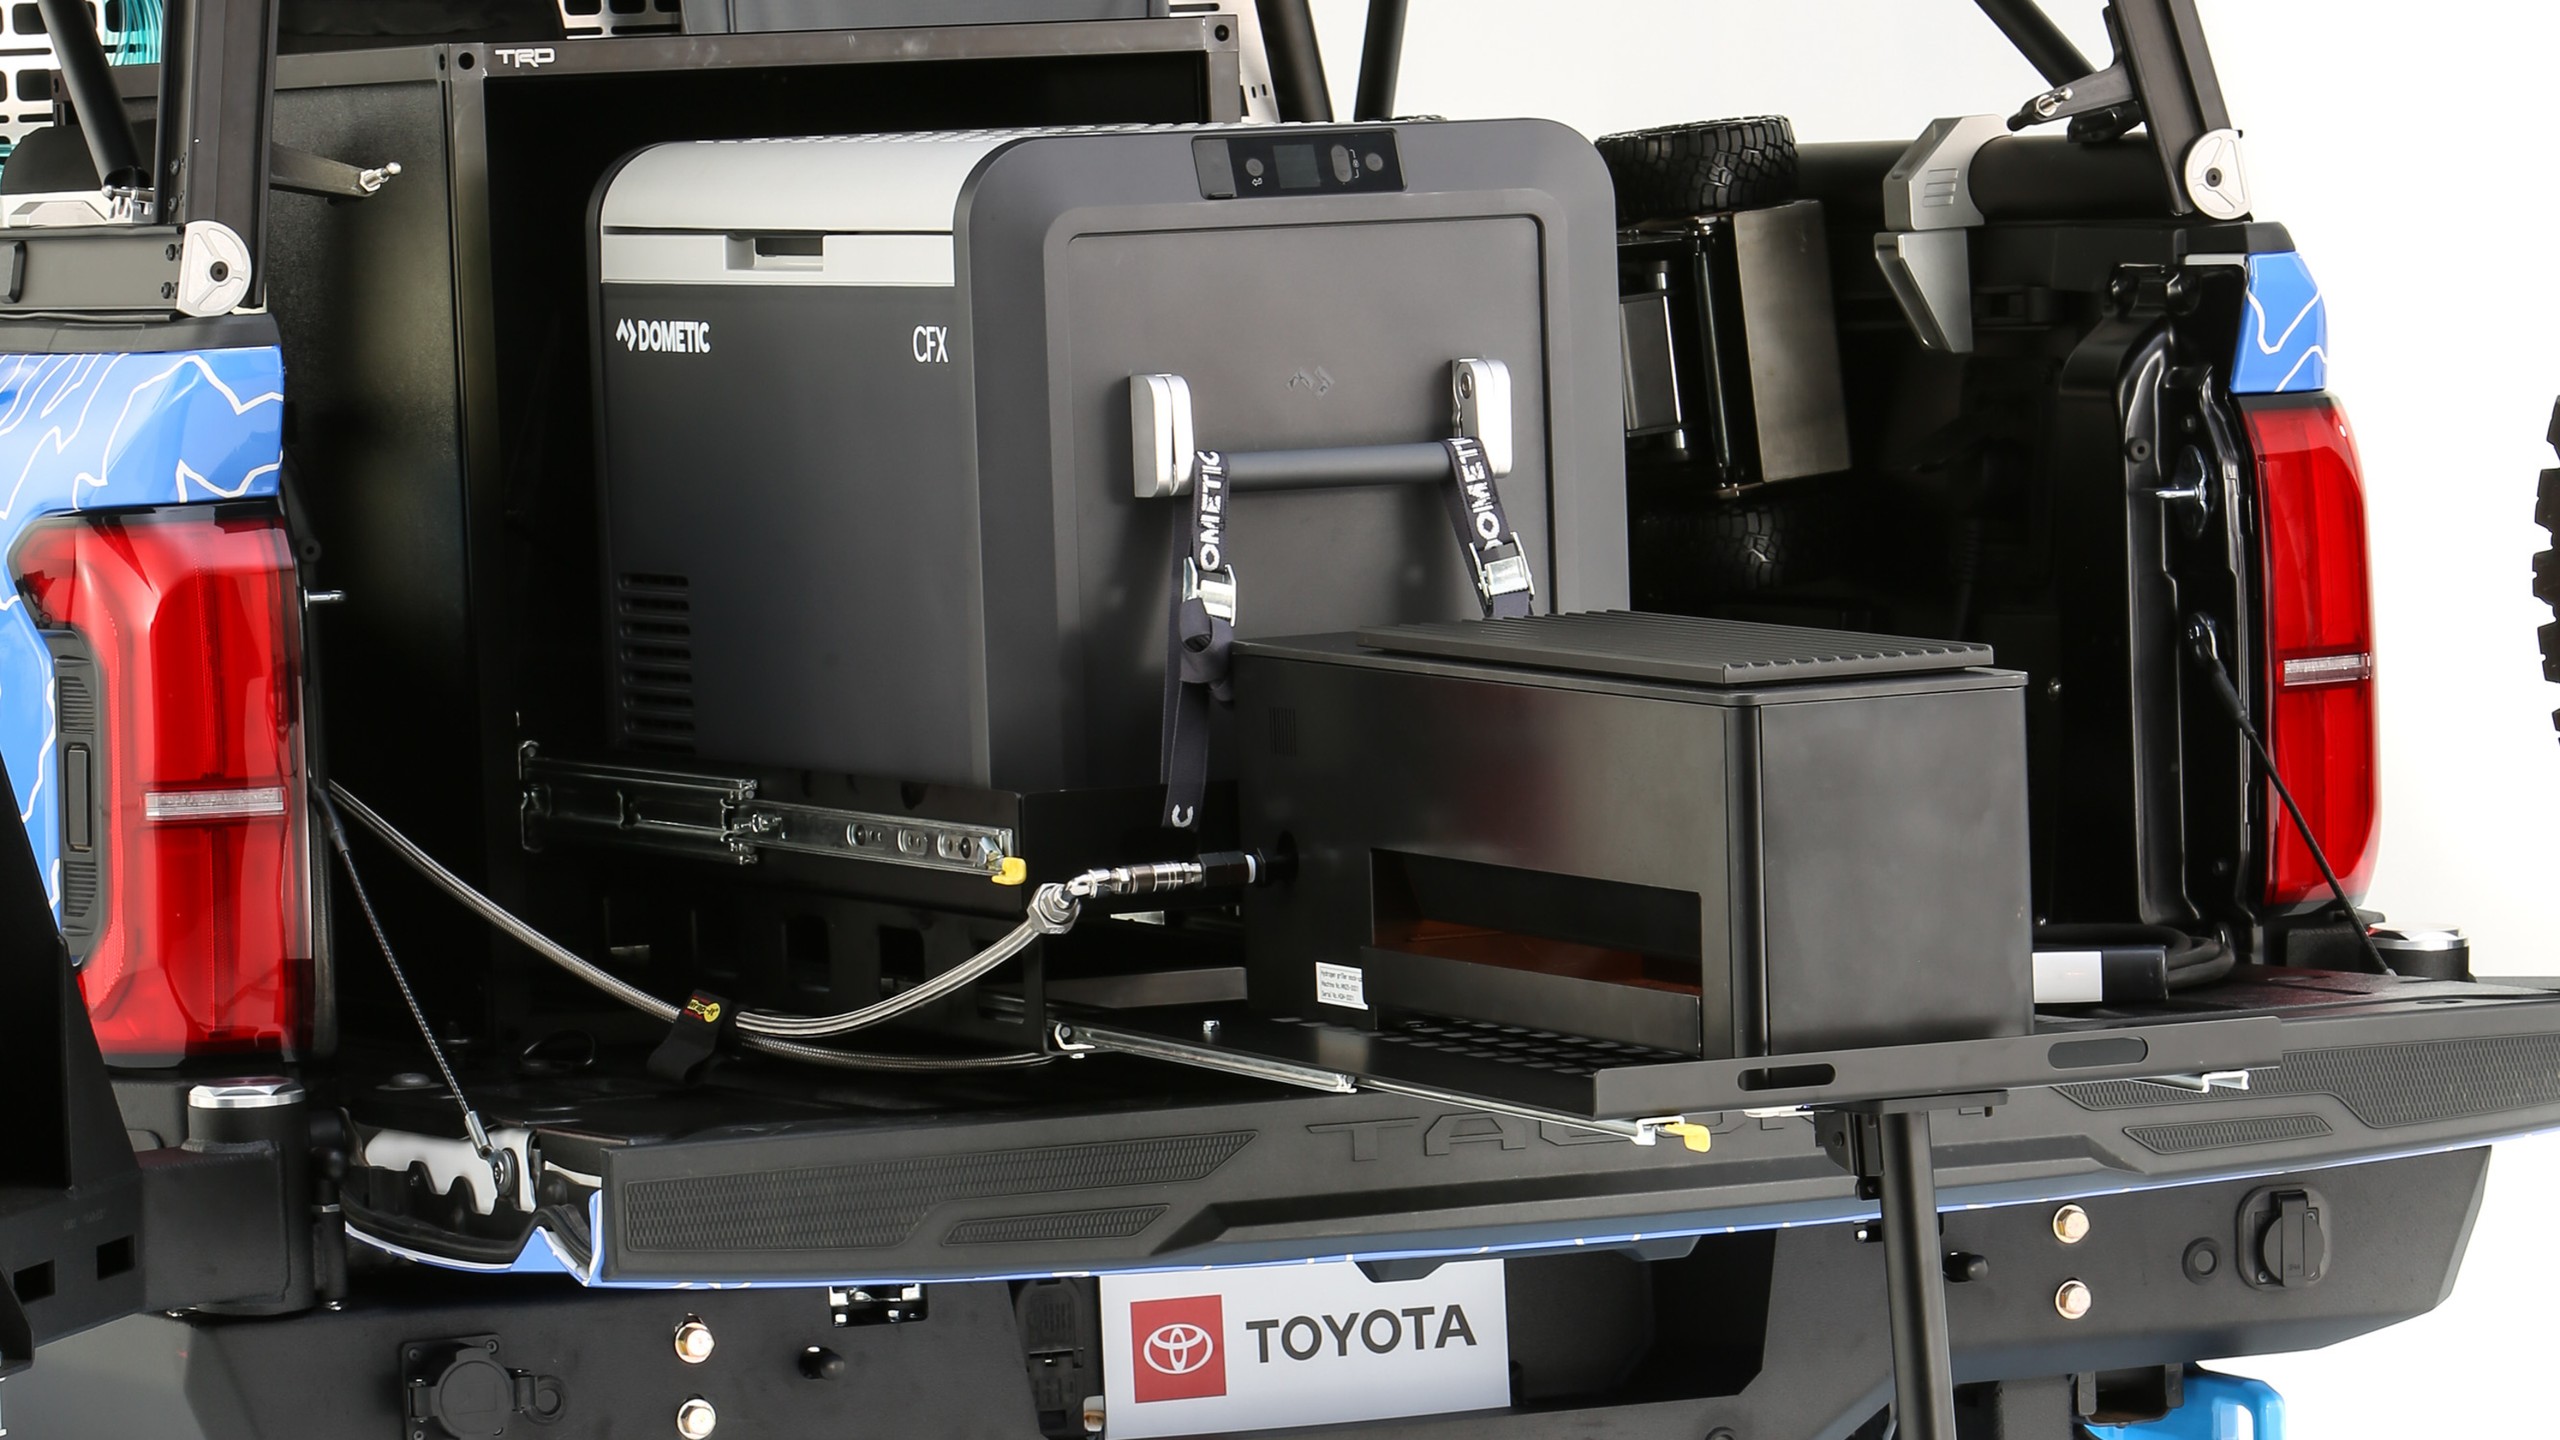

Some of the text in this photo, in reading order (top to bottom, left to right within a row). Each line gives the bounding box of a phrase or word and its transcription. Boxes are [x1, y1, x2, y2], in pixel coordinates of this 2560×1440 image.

[495, 48, 555, 68] TRD
[638, 320, 711, 353] DOMETIC
[913, 325, 949, 363] CFX
[1197, 450, 1222, 571] OMETIC
[1245, 1303, 1477, 1363] TOYOTA
